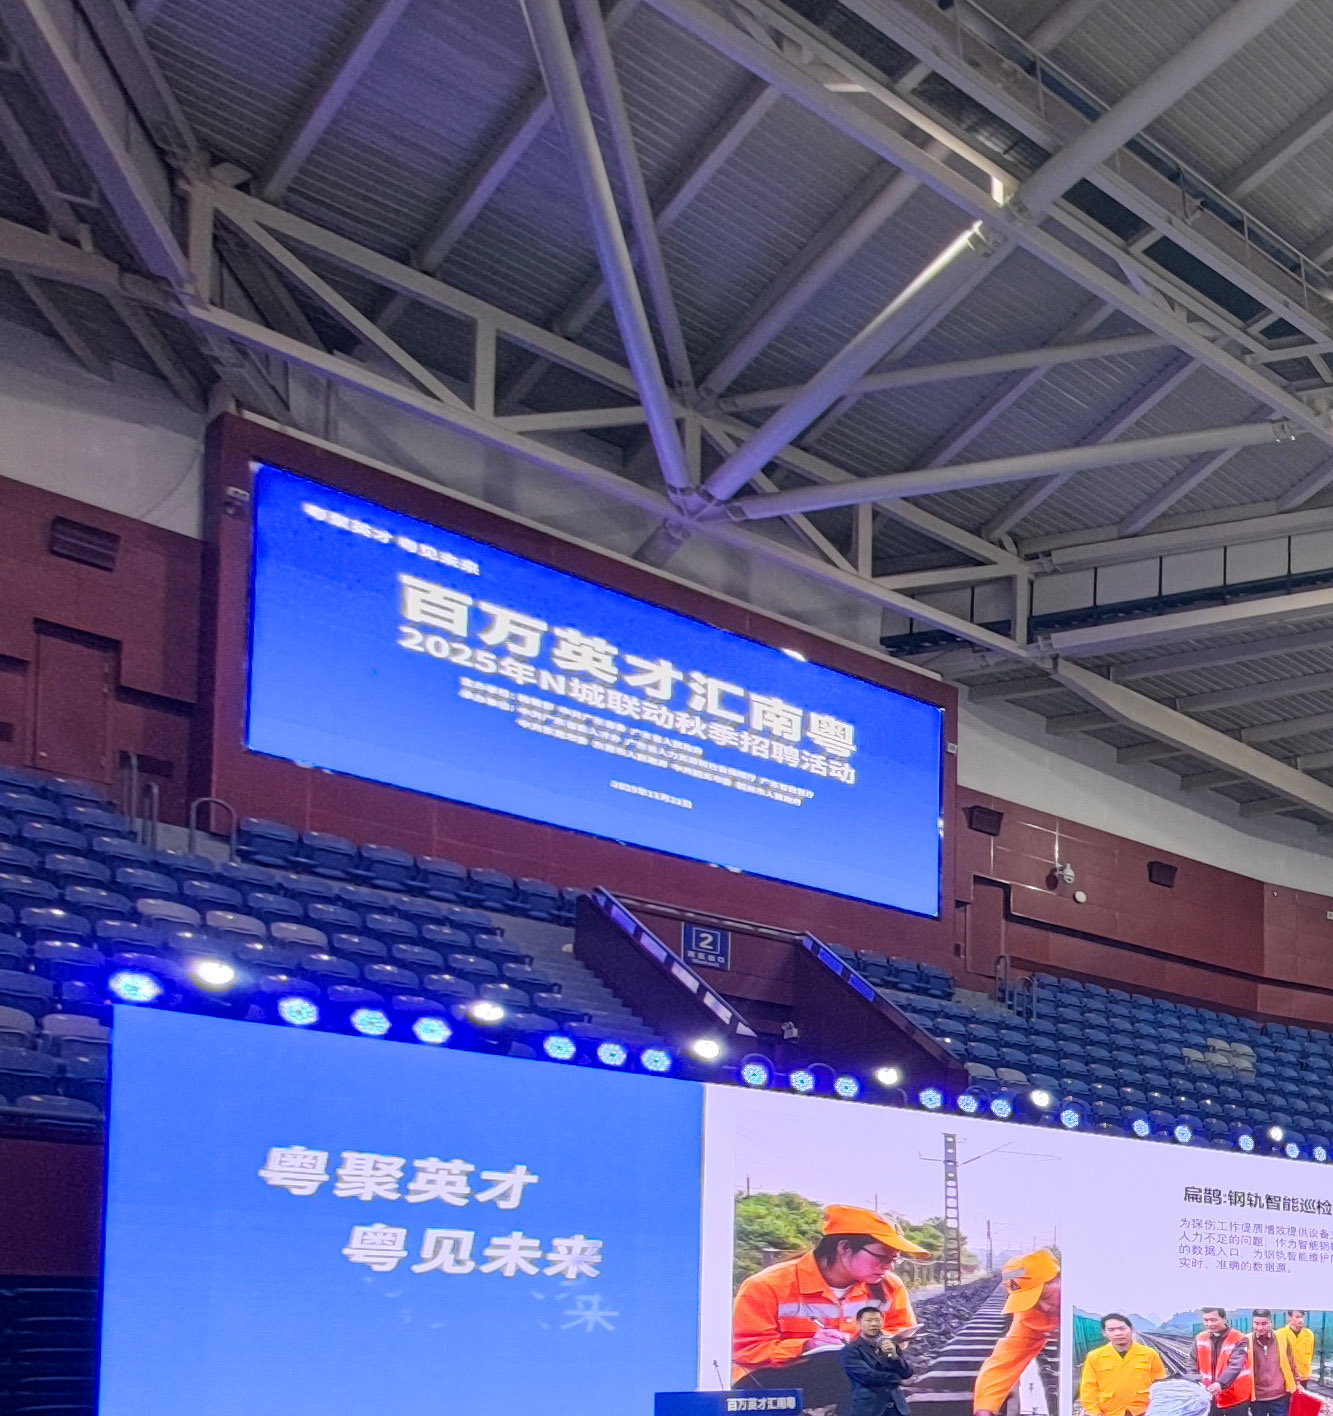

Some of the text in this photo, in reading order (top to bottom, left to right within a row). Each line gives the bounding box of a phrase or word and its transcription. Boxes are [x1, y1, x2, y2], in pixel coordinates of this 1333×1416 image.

[399, 573, 858, 761] 百万英才汇南粤
[397, 624, 858, 785] 2025年N城联动秋季招聘活动
[699, 932, 714, 950] 2
[258, 1144, 539, 1210] 粤聚英才
[342, 1223, 604, 1279] 粤见未来
